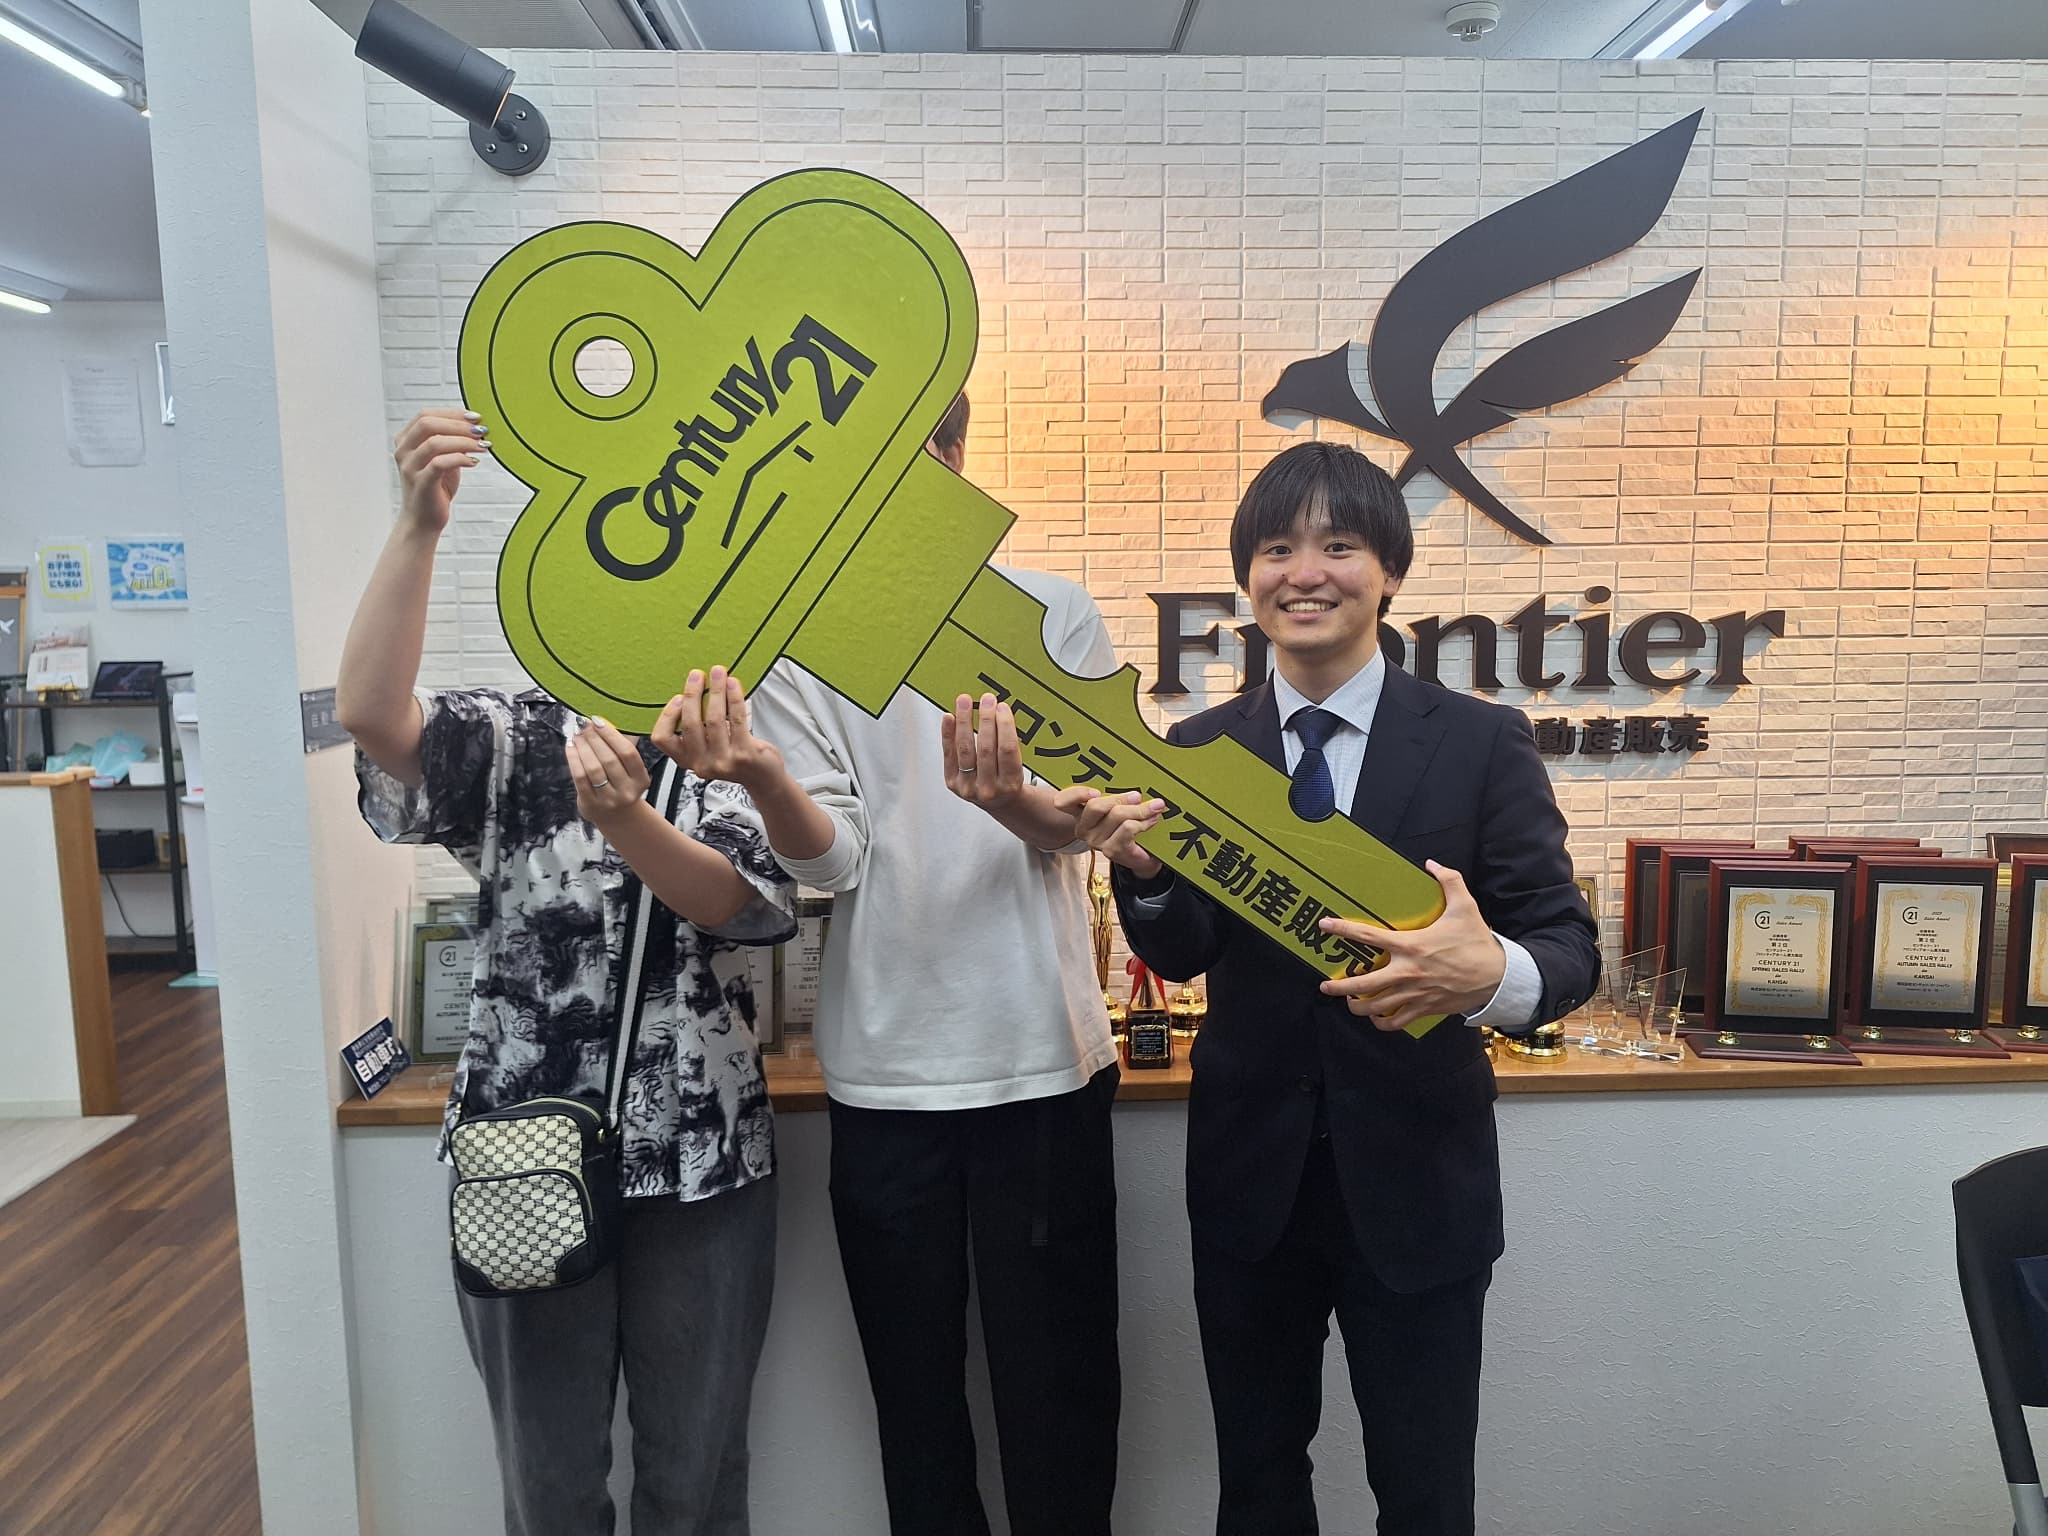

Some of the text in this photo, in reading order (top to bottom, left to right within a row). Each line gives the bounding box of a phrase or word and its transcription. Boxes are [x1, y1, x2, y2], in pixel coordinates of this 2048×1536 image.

[586, 314, 878, 581] Century 21
[1146, 585, 1786, 694] Frntier
